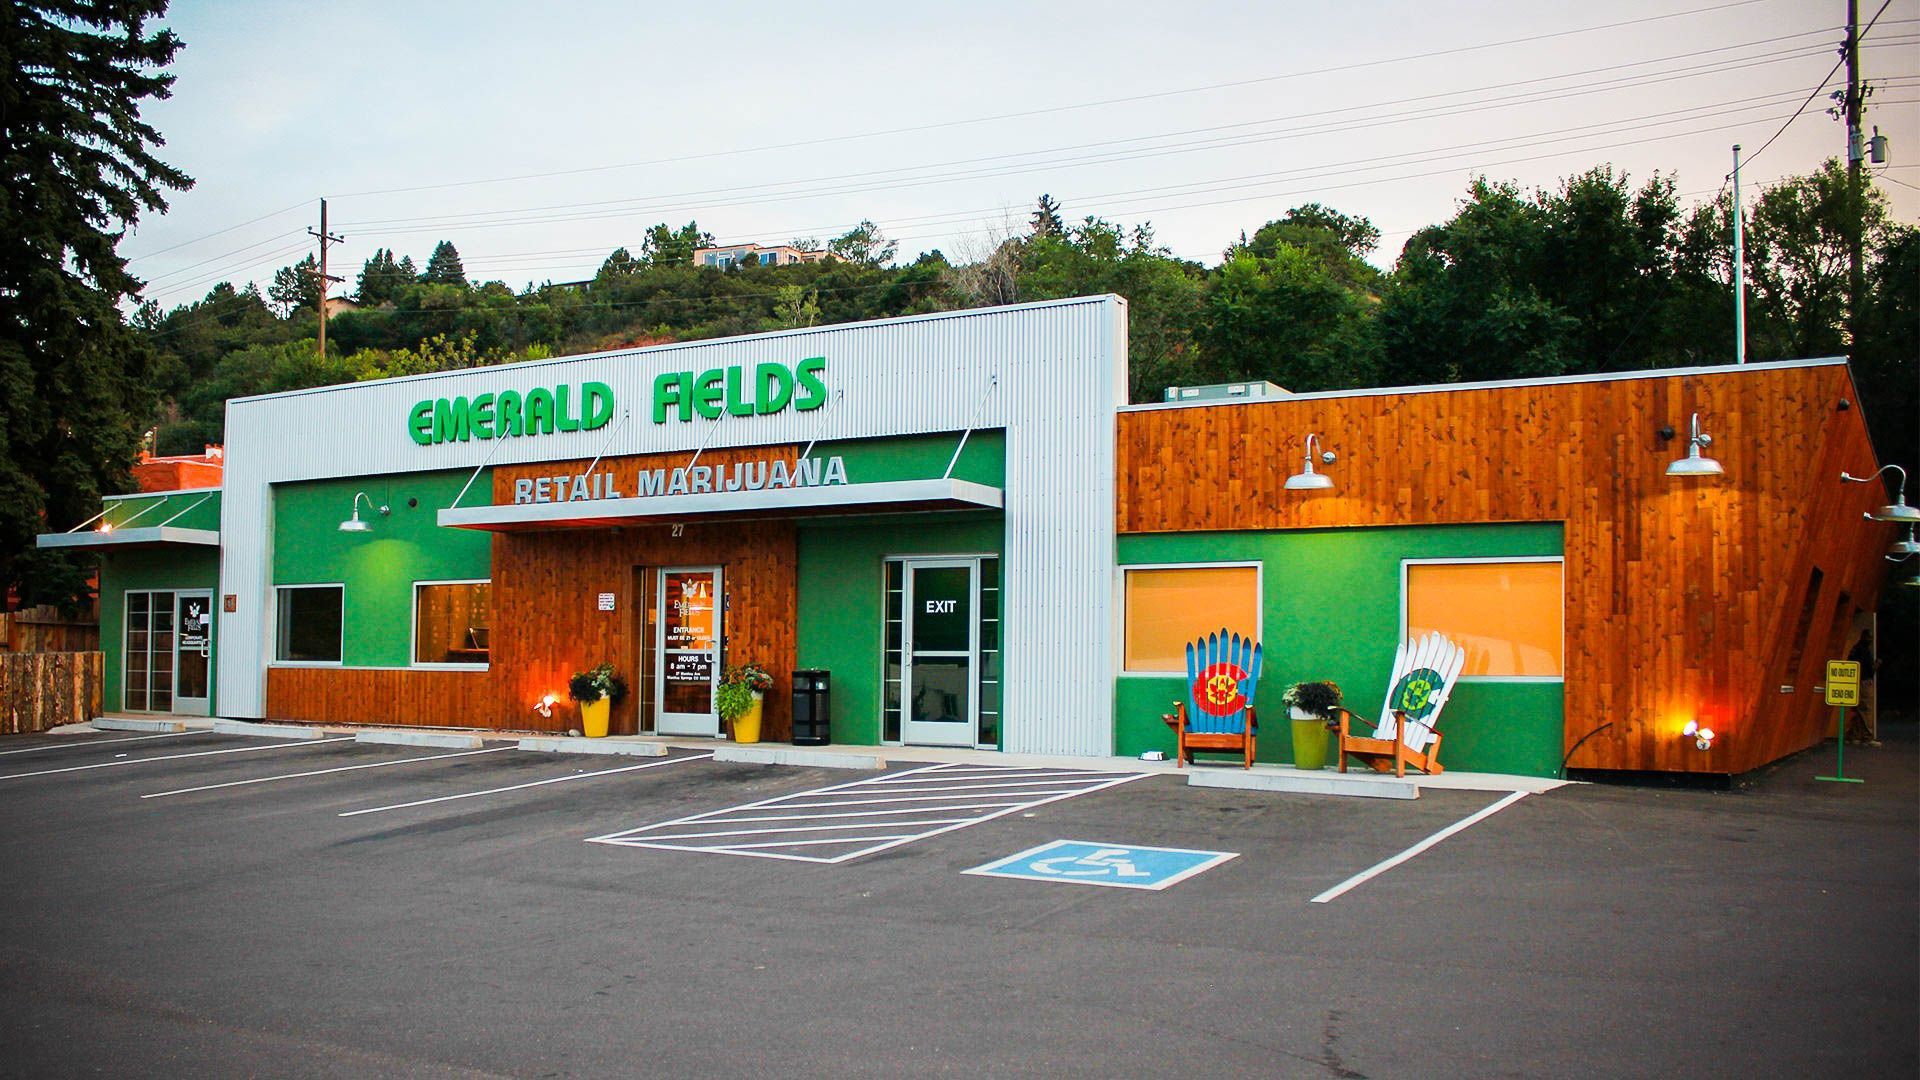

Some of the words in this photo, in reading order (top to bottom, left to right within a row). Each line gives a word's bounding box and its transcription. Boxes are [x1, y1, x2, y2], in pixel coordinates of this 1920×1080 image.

[408, 382, 615, 446] EMERALD
[653, 357, 827, 424] FIELDS
[514, 473, 620, 505] RETAIL
[637, 456, 848, 497] MARIJUANA
[671, 523, 685, 537] 27
[926, 600, 956, 613] EXIT
[1839, 668, 1856, 677] OUTLET
[1832, 689, 1844, 698] DEAD
[1844, 690, 1854, 699] END
